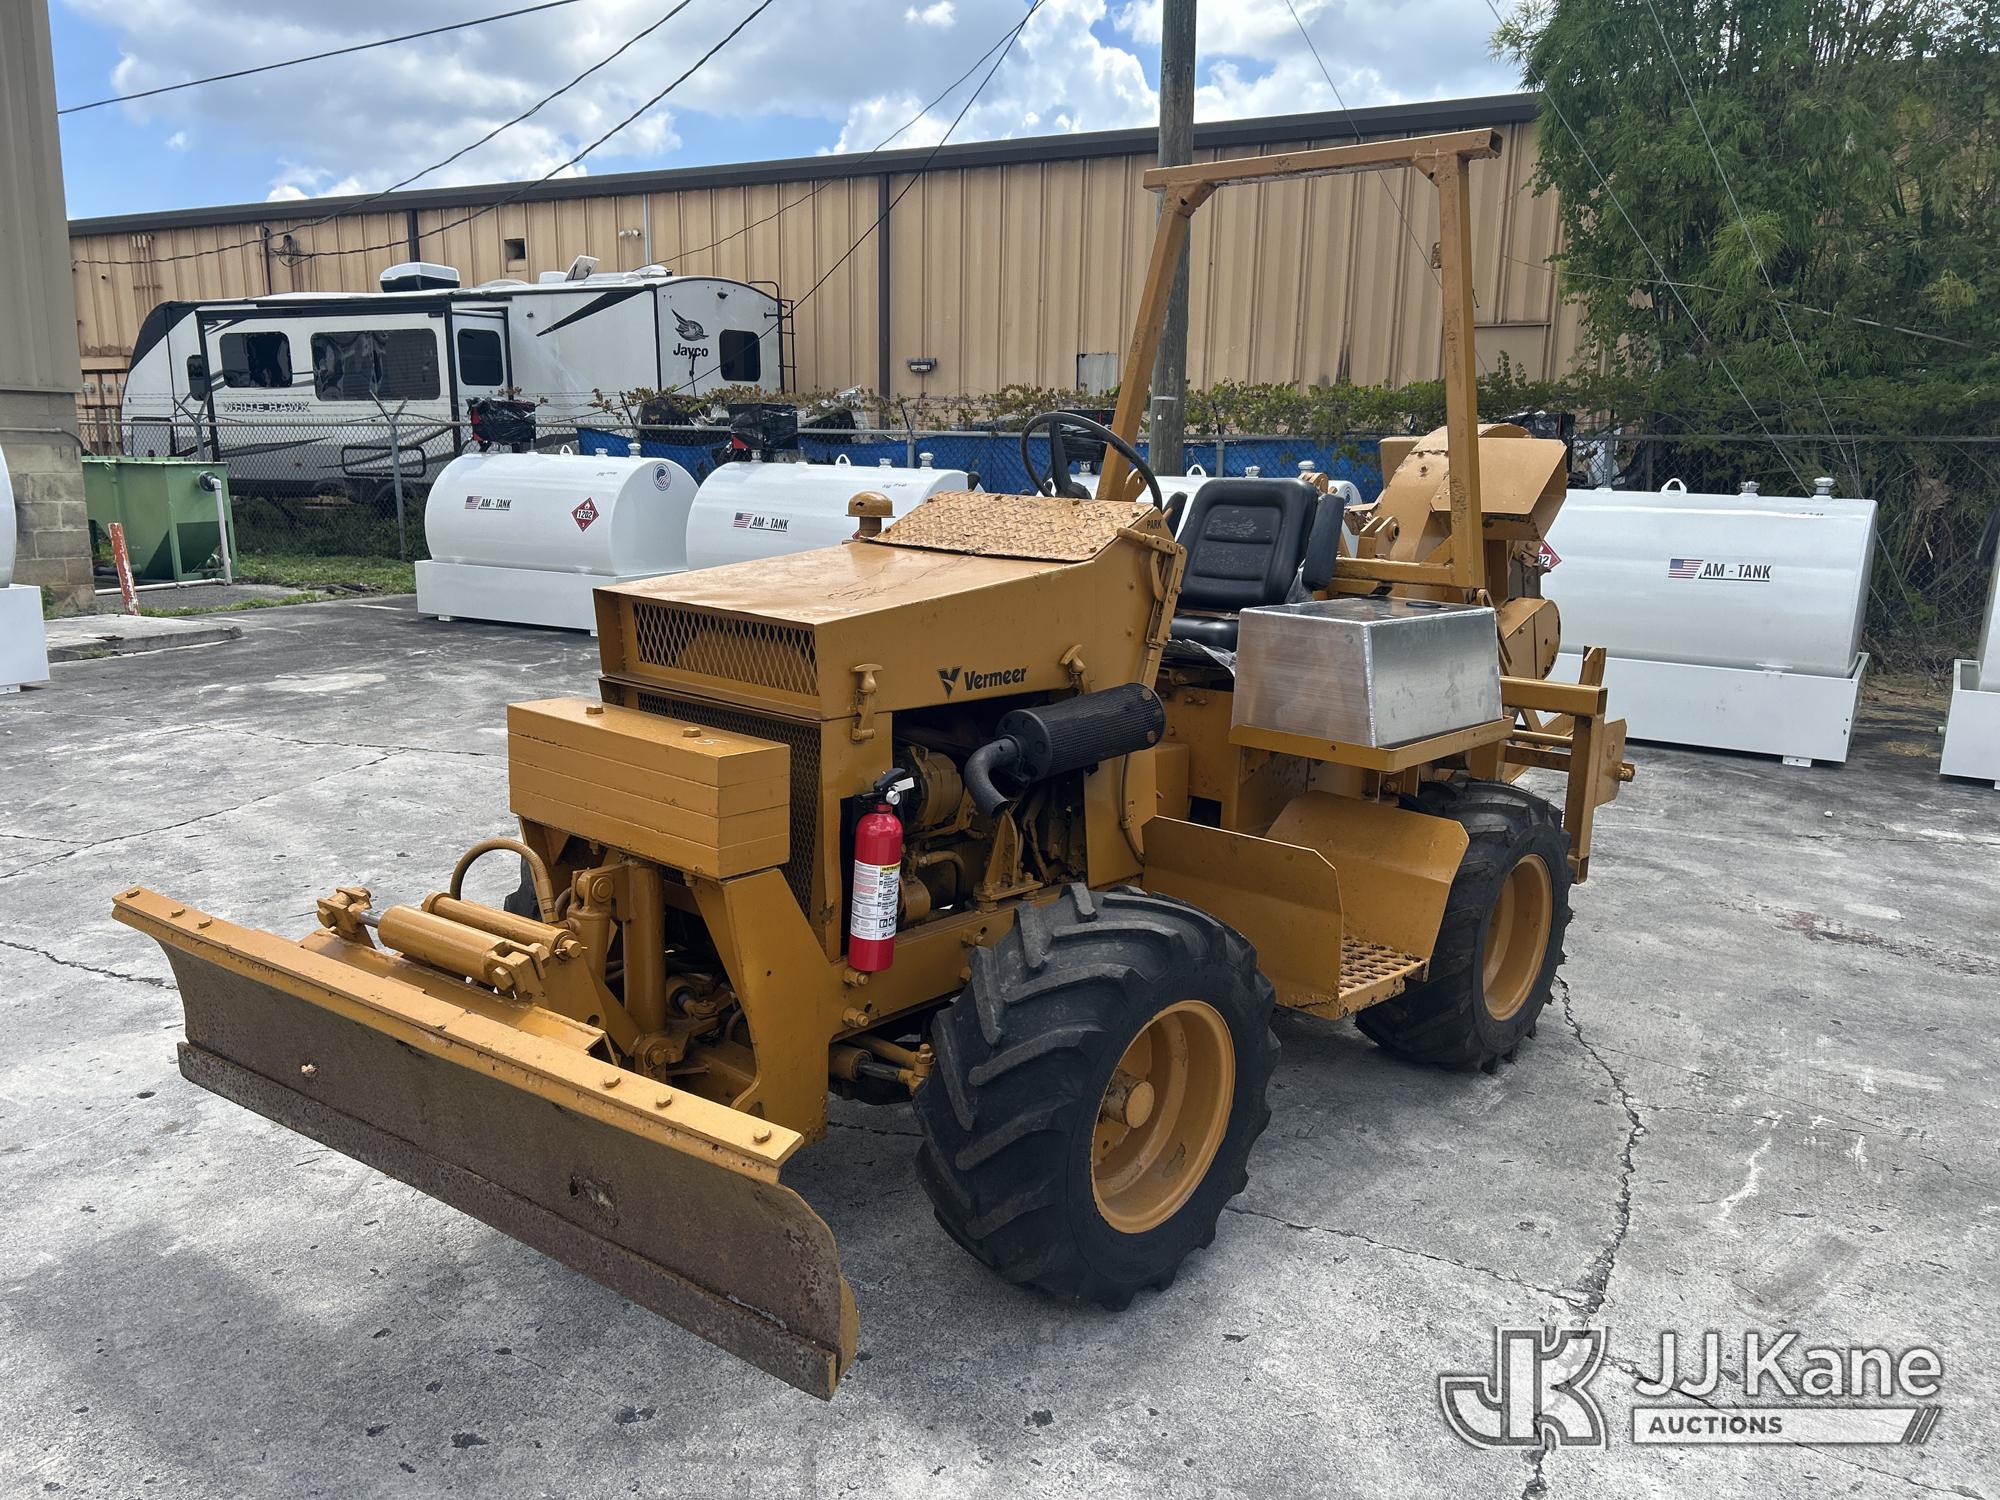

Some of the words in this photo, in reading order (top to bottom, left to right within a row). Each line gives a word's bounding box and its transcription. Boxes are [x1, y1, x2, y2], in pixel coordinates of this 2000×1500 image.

[673, 343, 709, 360] Jayco
[223, 401, 265, 413] WHITE
[268, 401, 311, 413] HAWK
[480, 498, 492, 508] AM
[495, 498, 512, 509] TANK
[578, 510, 593, 520] 1202
[752, 516, 764, 528] AM
[770, 517, 790, 531] TANK
[1146, 519, 1162, 530] PARK
[1703, 562, 1725, 577] AM
[1738, 564, 1772, 579] TANK
[963, 667, 1027, 691] Vermeer
